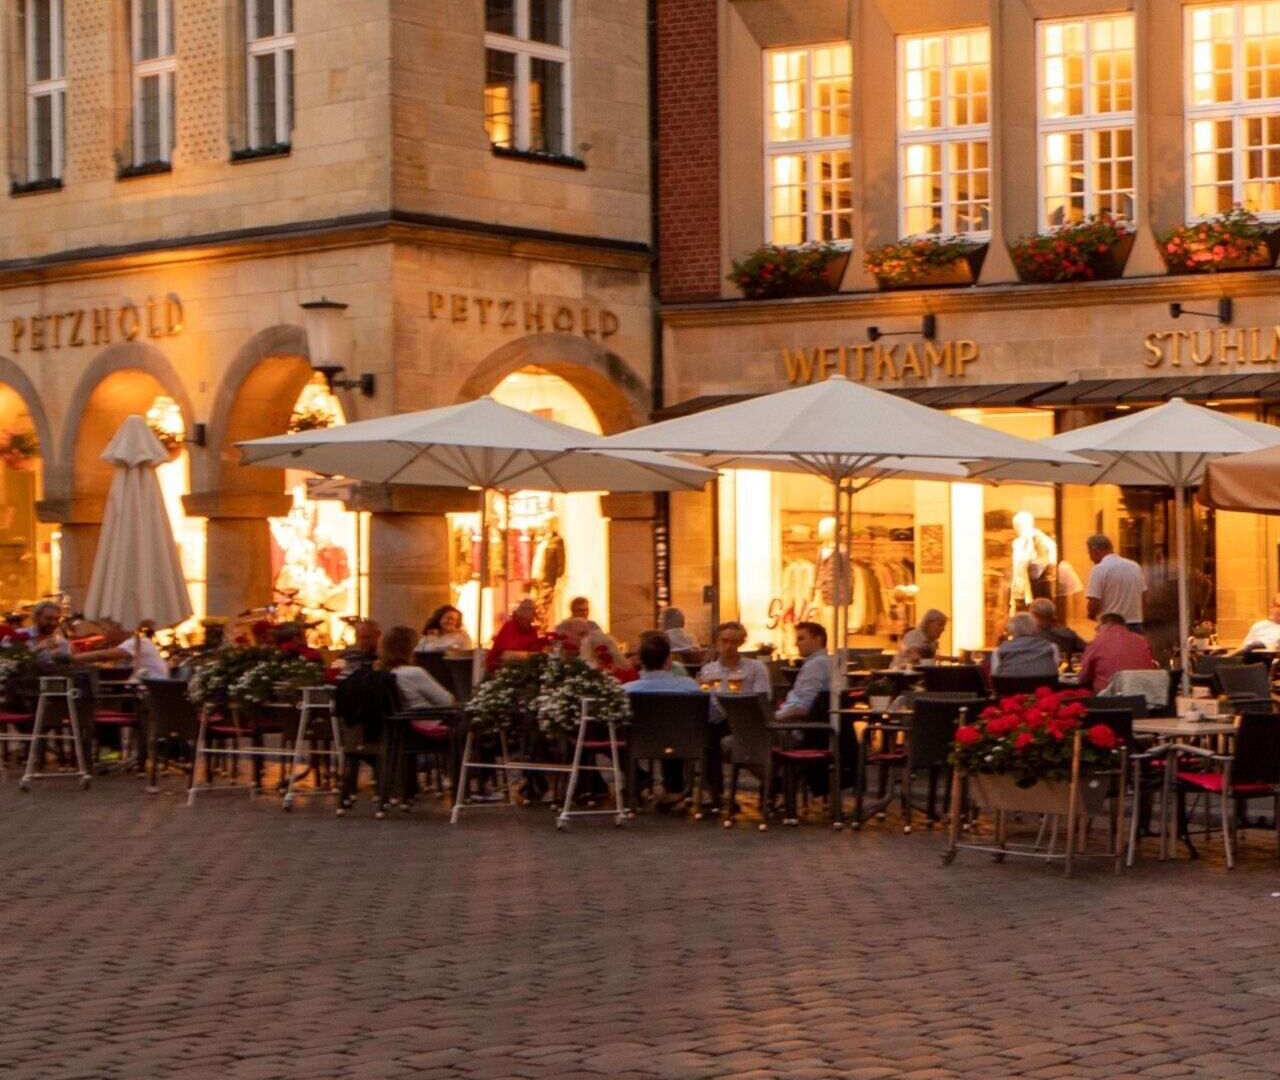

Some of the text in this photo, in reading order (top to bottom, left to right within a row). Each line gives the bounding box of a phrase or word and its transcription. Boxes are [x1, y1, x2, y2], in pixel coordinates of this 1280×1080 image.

[10, 293, 184, 353] PETZHOLD
[428, 291, 620, 338] PETZHOLD
[783, 340, 979, 383] WEITKAMP
